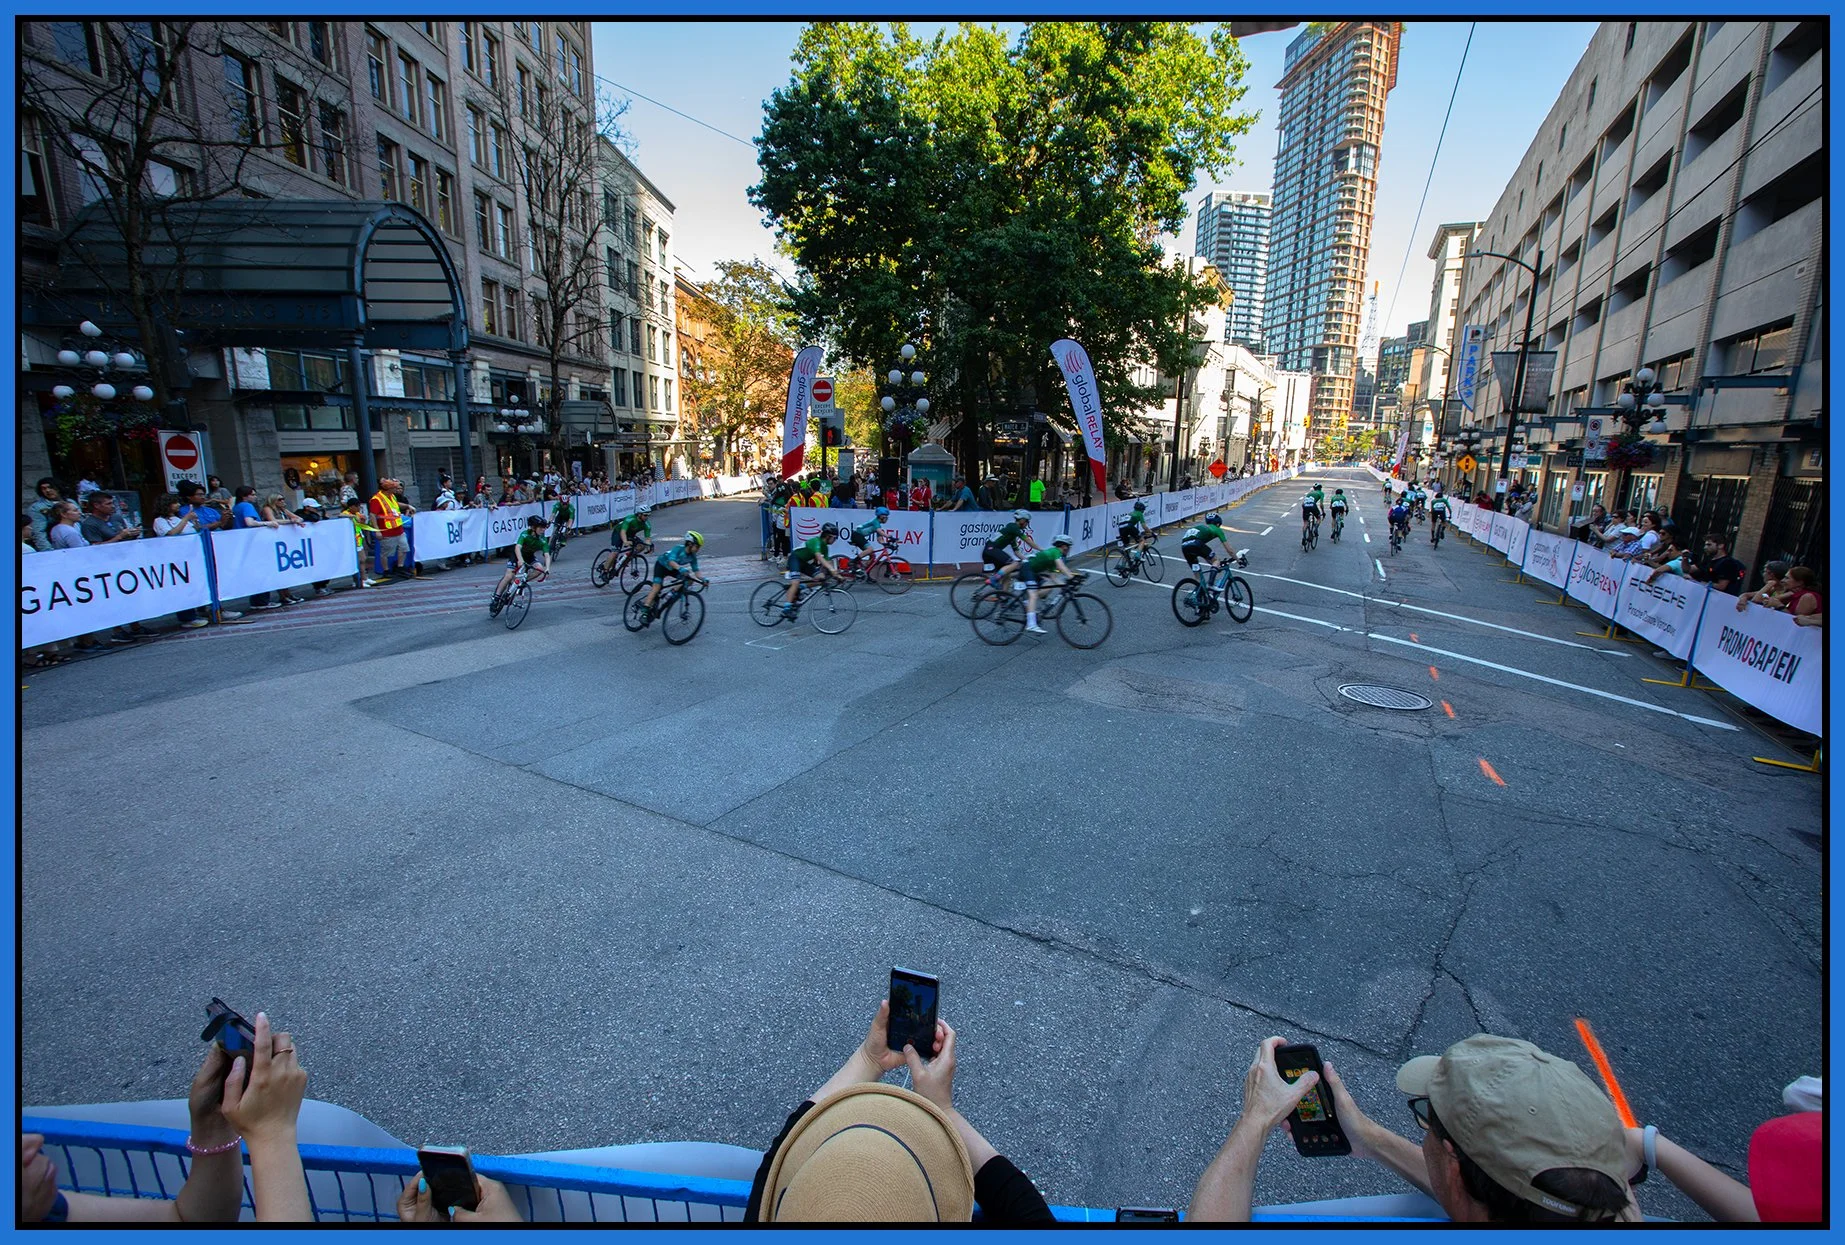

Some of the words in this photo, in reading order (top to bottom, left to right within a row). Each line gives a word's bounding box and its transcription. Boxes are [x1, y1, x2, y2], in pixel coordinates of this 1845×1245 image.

[1465, 345, 1479, 387] PARK
[171, 472, 198, 480] EXCEPT
[493, 517, 529, 533] GASTO
[275, 538, 314, 572] Bell
[22, 561, 190, 614] GASTOWN
[1718, 625, 1802, 685] PROMOSAPIEN
